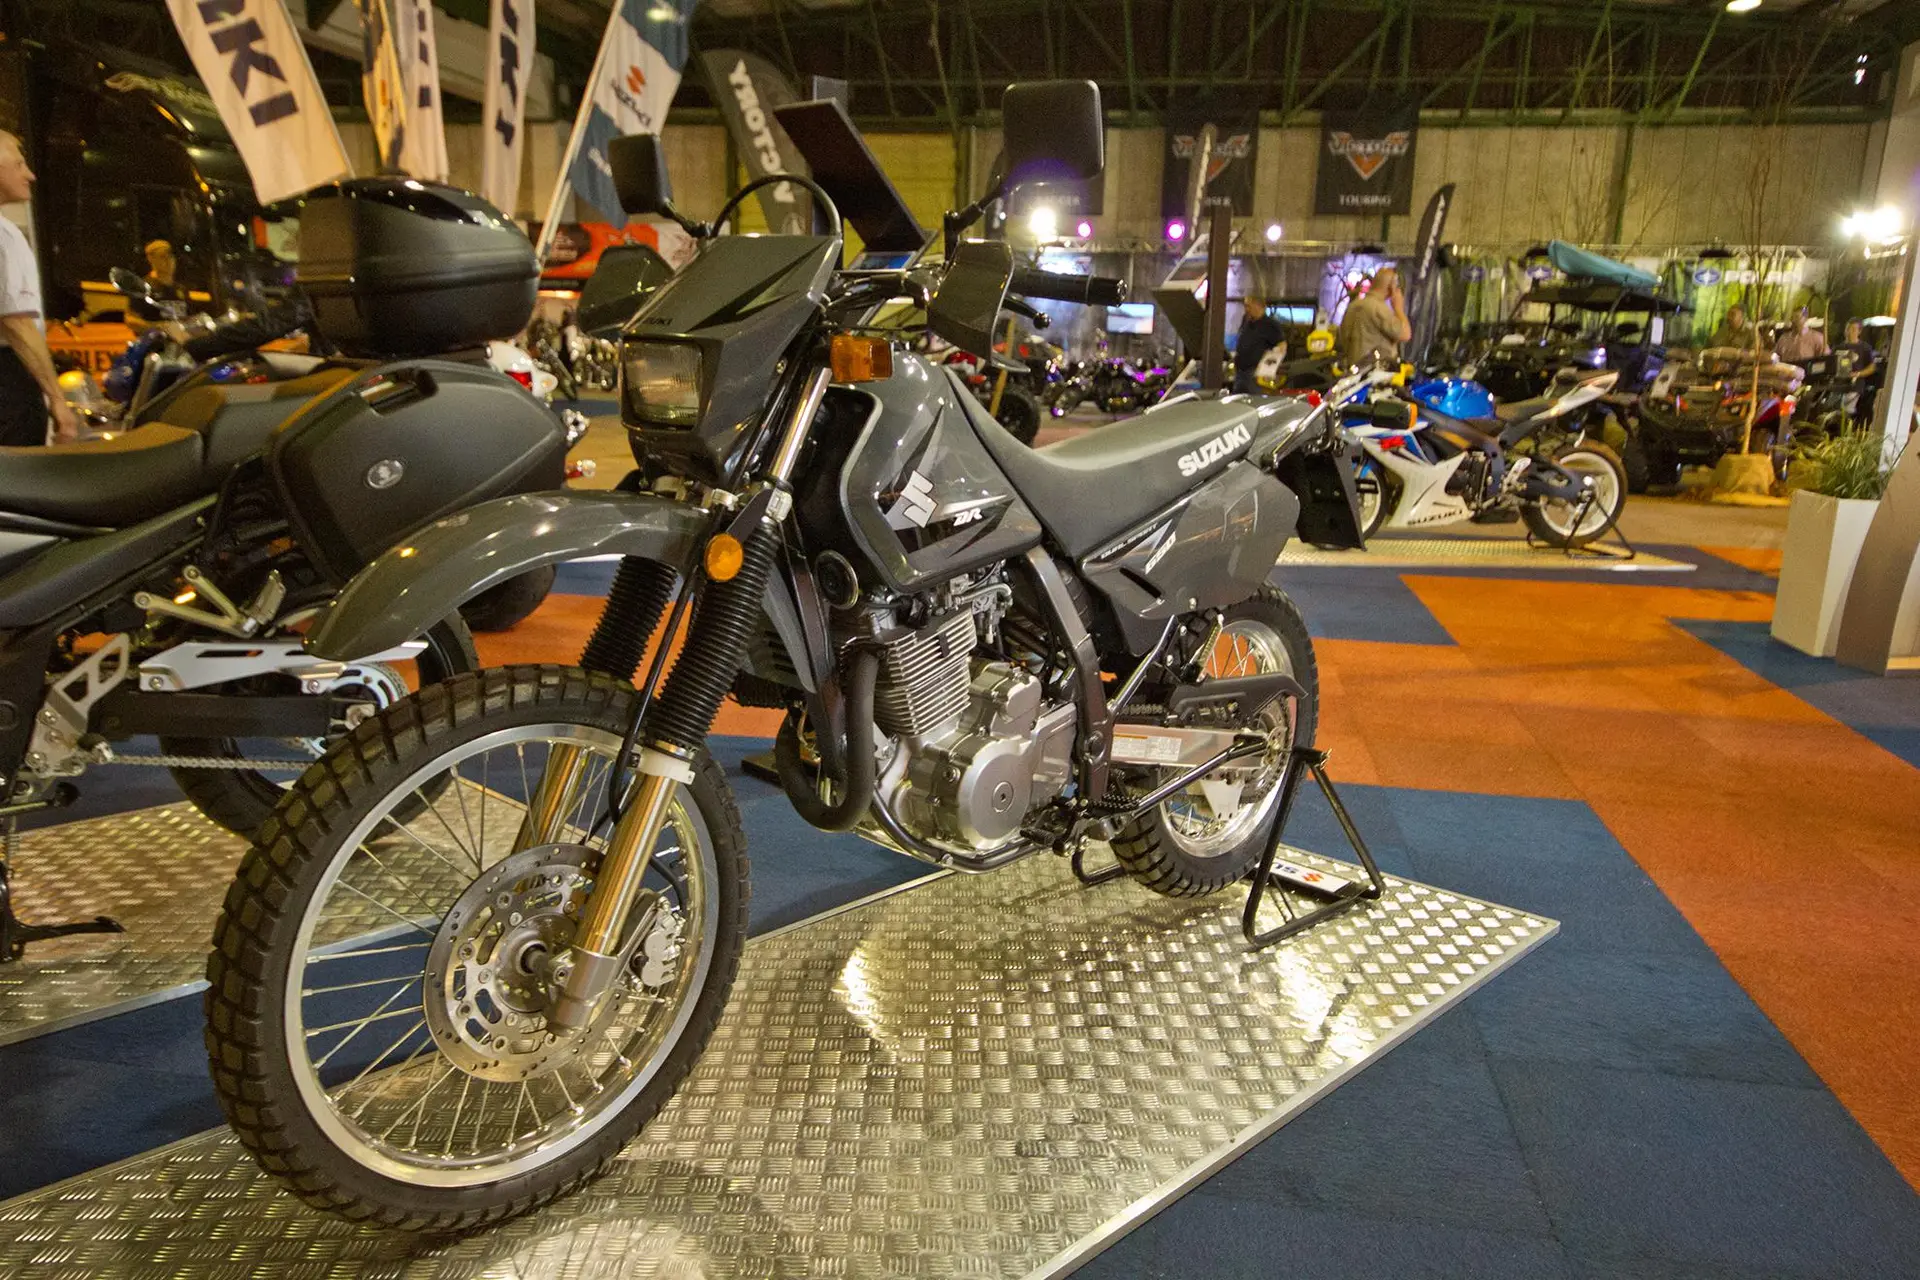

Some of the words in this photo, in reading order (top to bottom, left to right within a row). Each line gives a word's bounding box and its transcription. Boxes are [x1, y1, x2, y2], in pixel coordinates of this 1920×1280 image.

[1178, 423, 1251, 477] SUZUKI
[953, 508, 983, 527] DR
[1407, 508, 1463, 526] SUZUKI
[1145, 531, 1176, 574] 650
